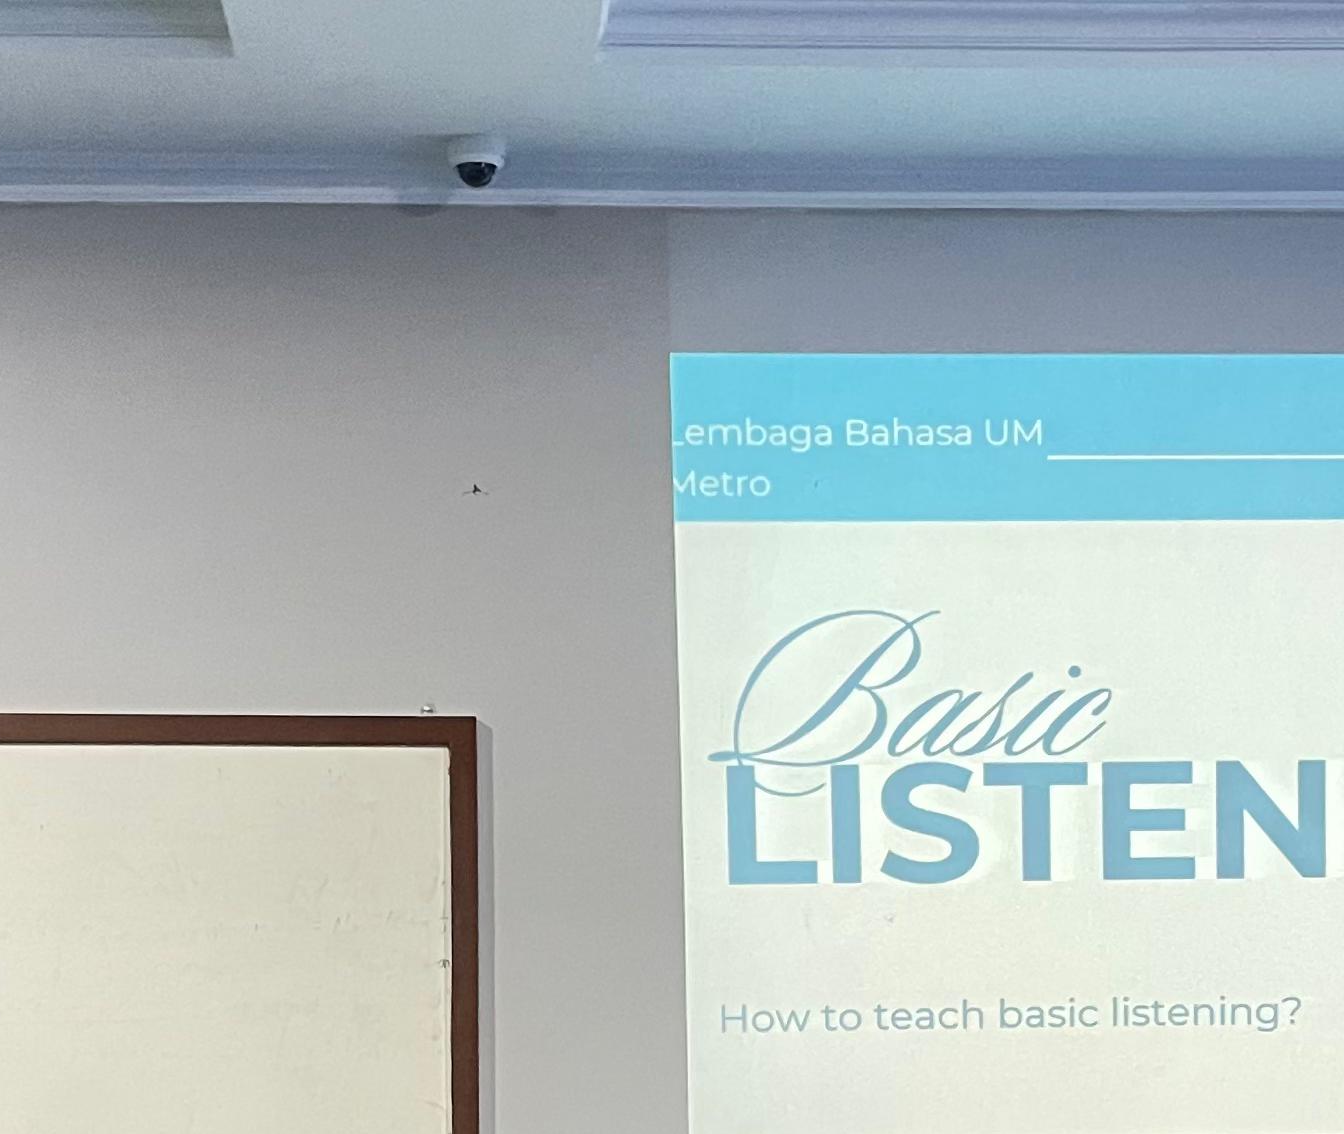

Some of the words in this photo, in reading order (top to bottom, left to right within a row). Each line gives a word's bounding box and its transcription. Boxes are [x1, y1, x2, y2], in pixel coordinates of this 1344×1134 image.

[845, 417, 973, 447] Bahasa
[984, 418, 1043, 446] UM
[673, 469, 772, 498] Metro
[707, 609, 1113, 790] Basic
[720, 1003, 812, 1034] How
[822, 1003, 864, 1033] to
[874, 998, 985, 1032] teach
[999, 997, 1100, 1030] basic
[1112, 995, 1303, 1033] listening?
